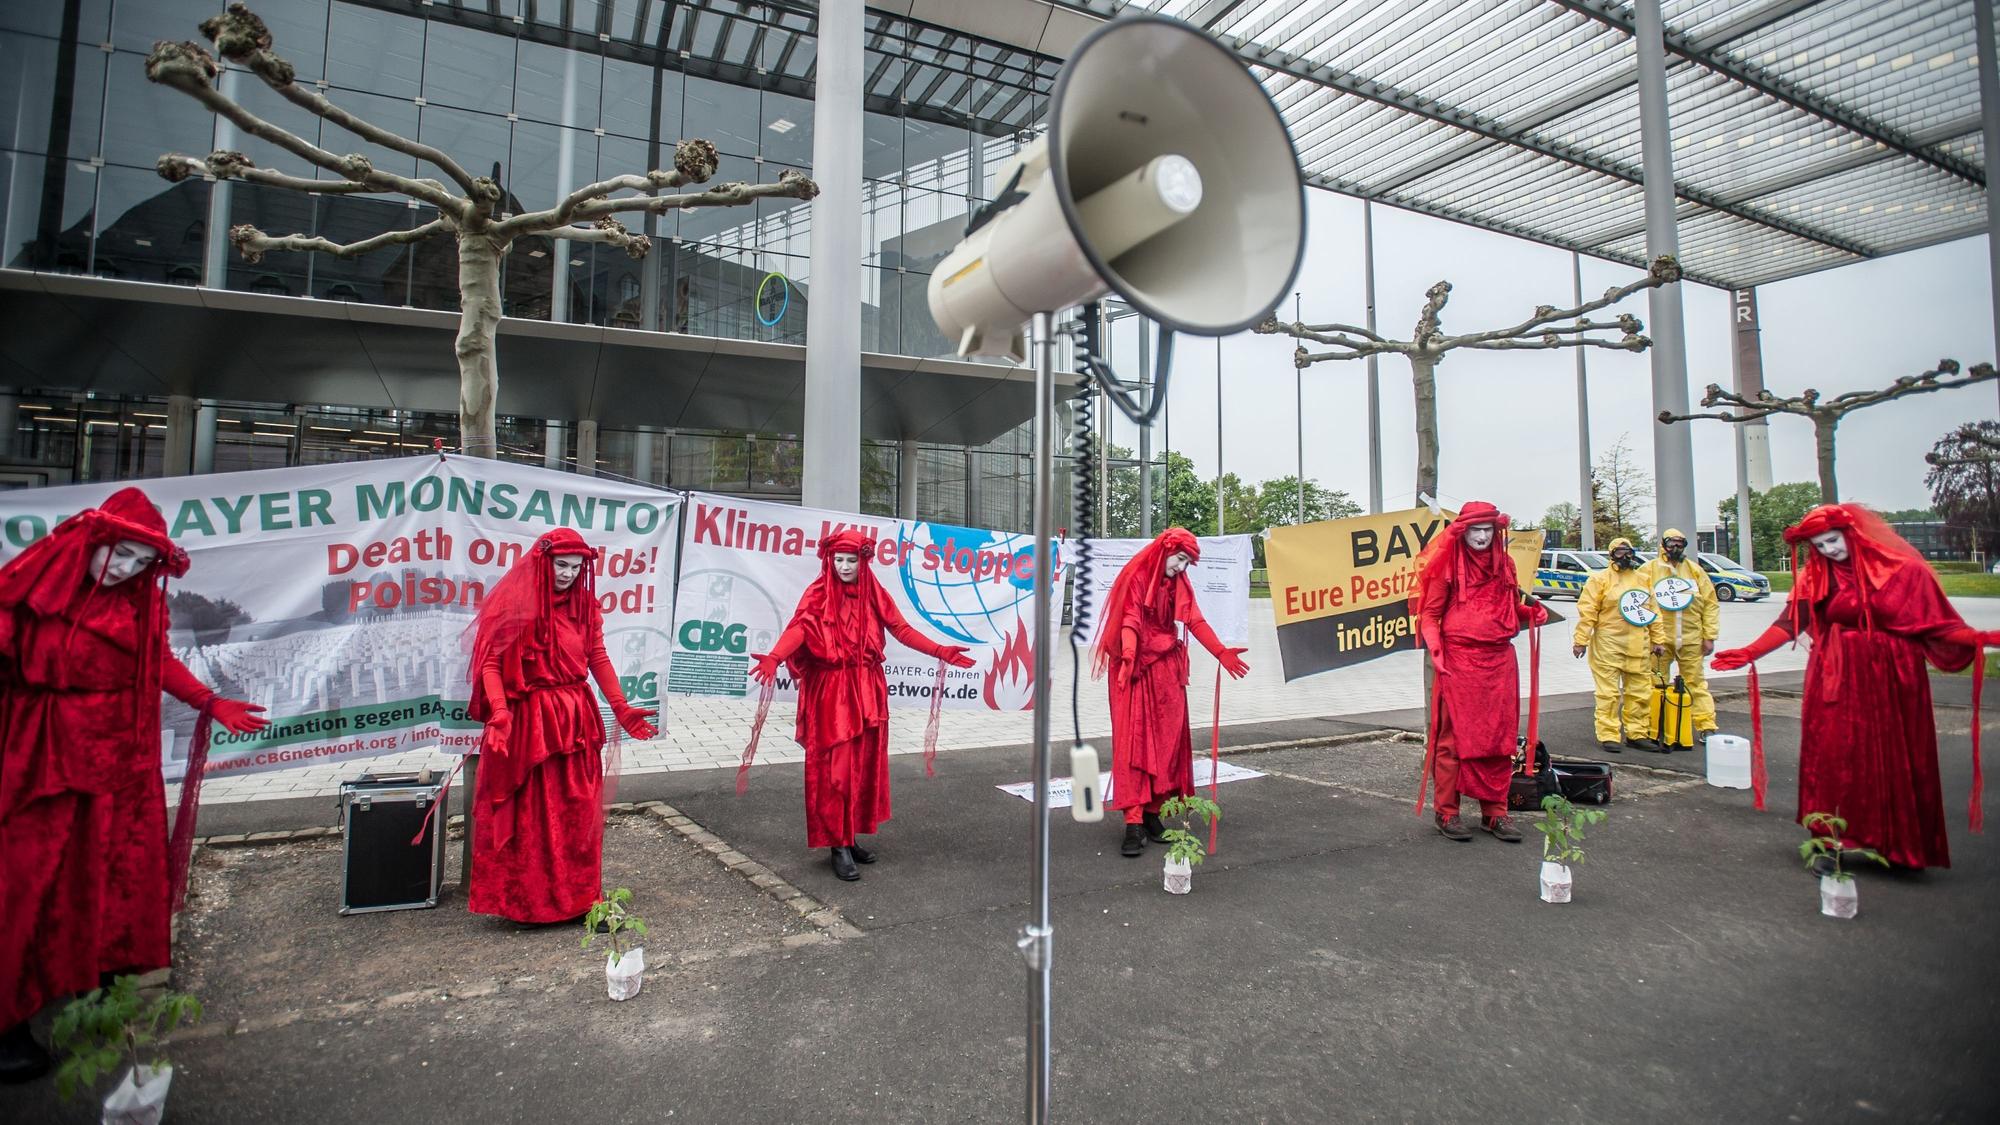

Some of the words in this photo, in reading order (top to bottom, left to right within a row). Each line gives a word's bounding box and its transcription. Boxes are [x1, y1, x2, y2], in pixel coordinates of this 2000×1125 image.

[158, 488, 336, 539] AYER
[327, 526, 453, 576] Death
[468, 538, 524, 567] on
[594, 546, 658, 578] lds!
[921, 537, 1061, 584] stoppe!
[1351, 519, 1450, 568] BAY
[350, 570, 485, 613] Poison
[600, 584, 656, 614] od!
[1285, 584, 1344, 616] Eure
[1351, 564, 1422, 604] Pestiz
[1630, 591, 1647, 622] BAYER
[1667, 579, 1679, 607] BAYER
[678, 619, 747, 654] CBG
[884, 664, 980, 681] BAYER-Gefahren
[213, 716, 348, 747] Coordination
[353, 706, 414, 730] gegen
